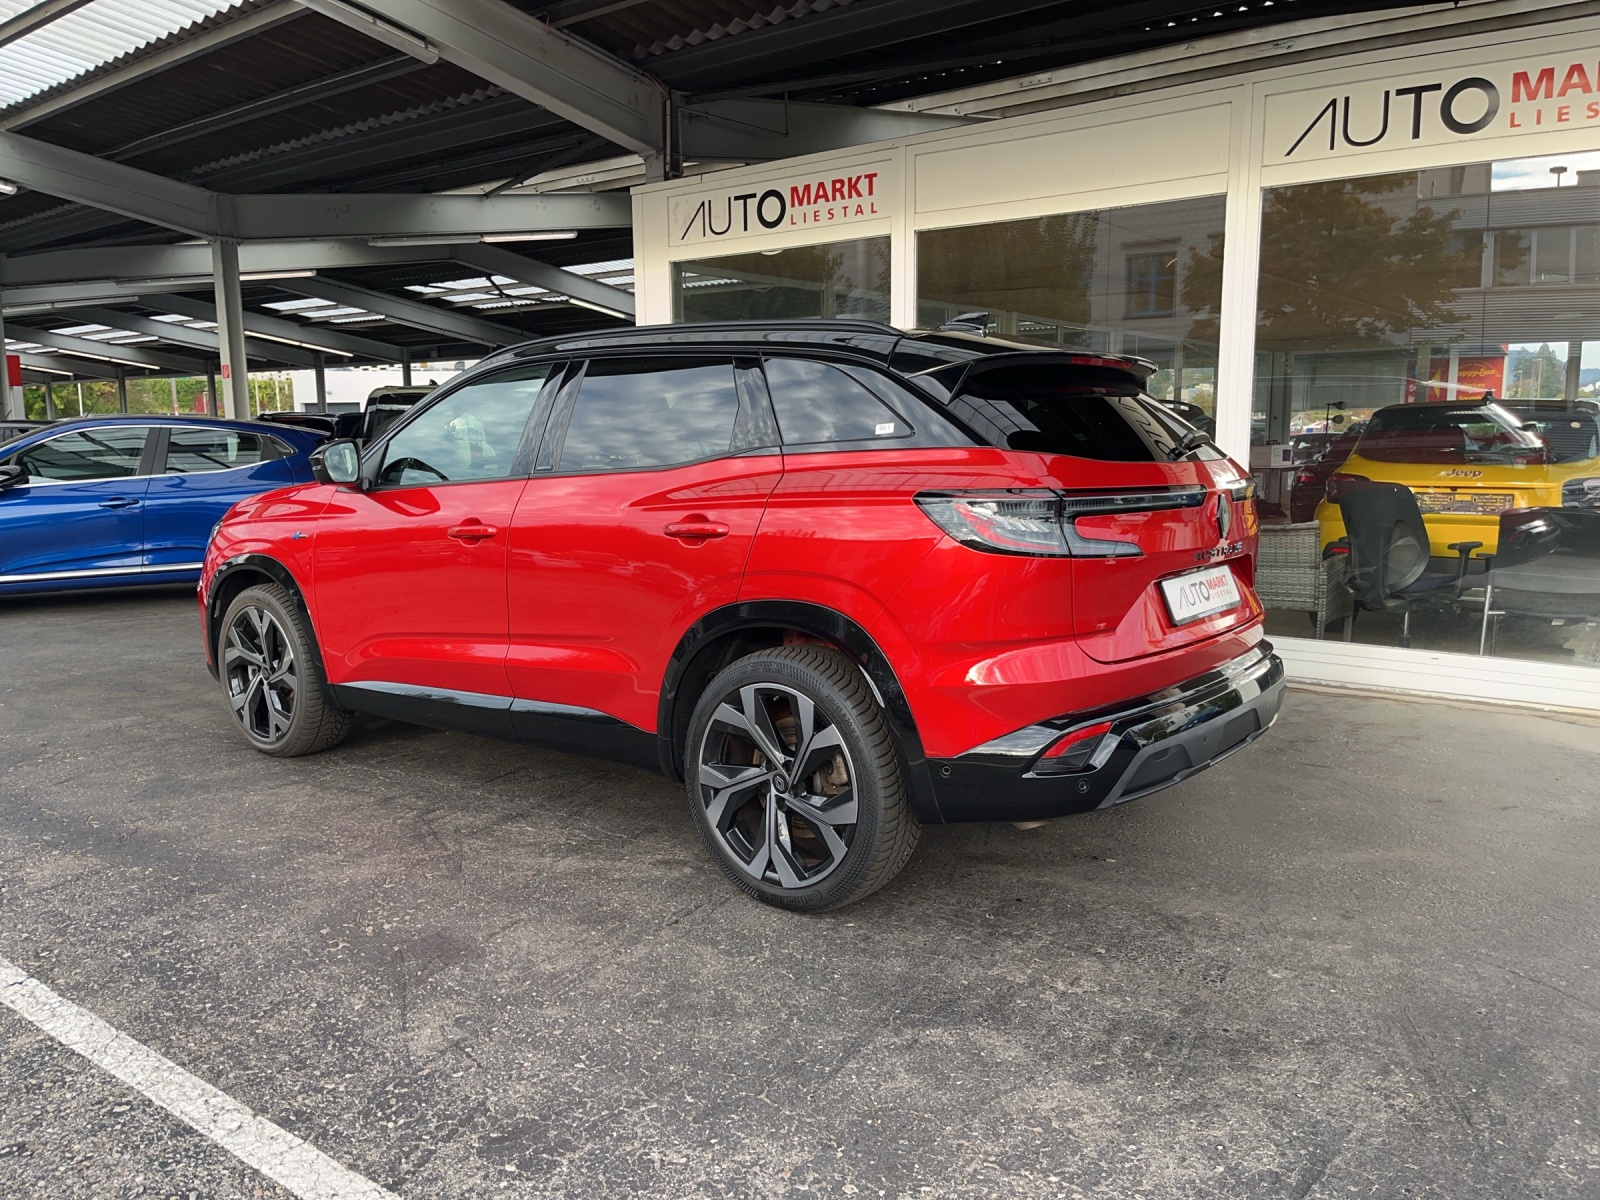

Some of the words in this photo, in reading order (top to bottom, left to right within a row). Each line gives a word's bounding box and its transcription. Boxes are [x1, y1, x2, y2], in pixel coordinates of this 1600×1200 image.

[1284, 77, 1500, 156] AUTO
[1511, 60, 1600, 103] MA
[1509, 101, 1600, 128] LIES
[680, 189, 786, 240] AUTO
[790, 172, 878, 208] MARKT
[790, 202, 878, 225] LIESTAL
[1446, 468, 1483, 479] Jeep
[1179, 580, 1210, 610] AUTO
[1205, 574, 1229, 591] MARKT
[1211, 588, 1233, 600] LIESTAL
